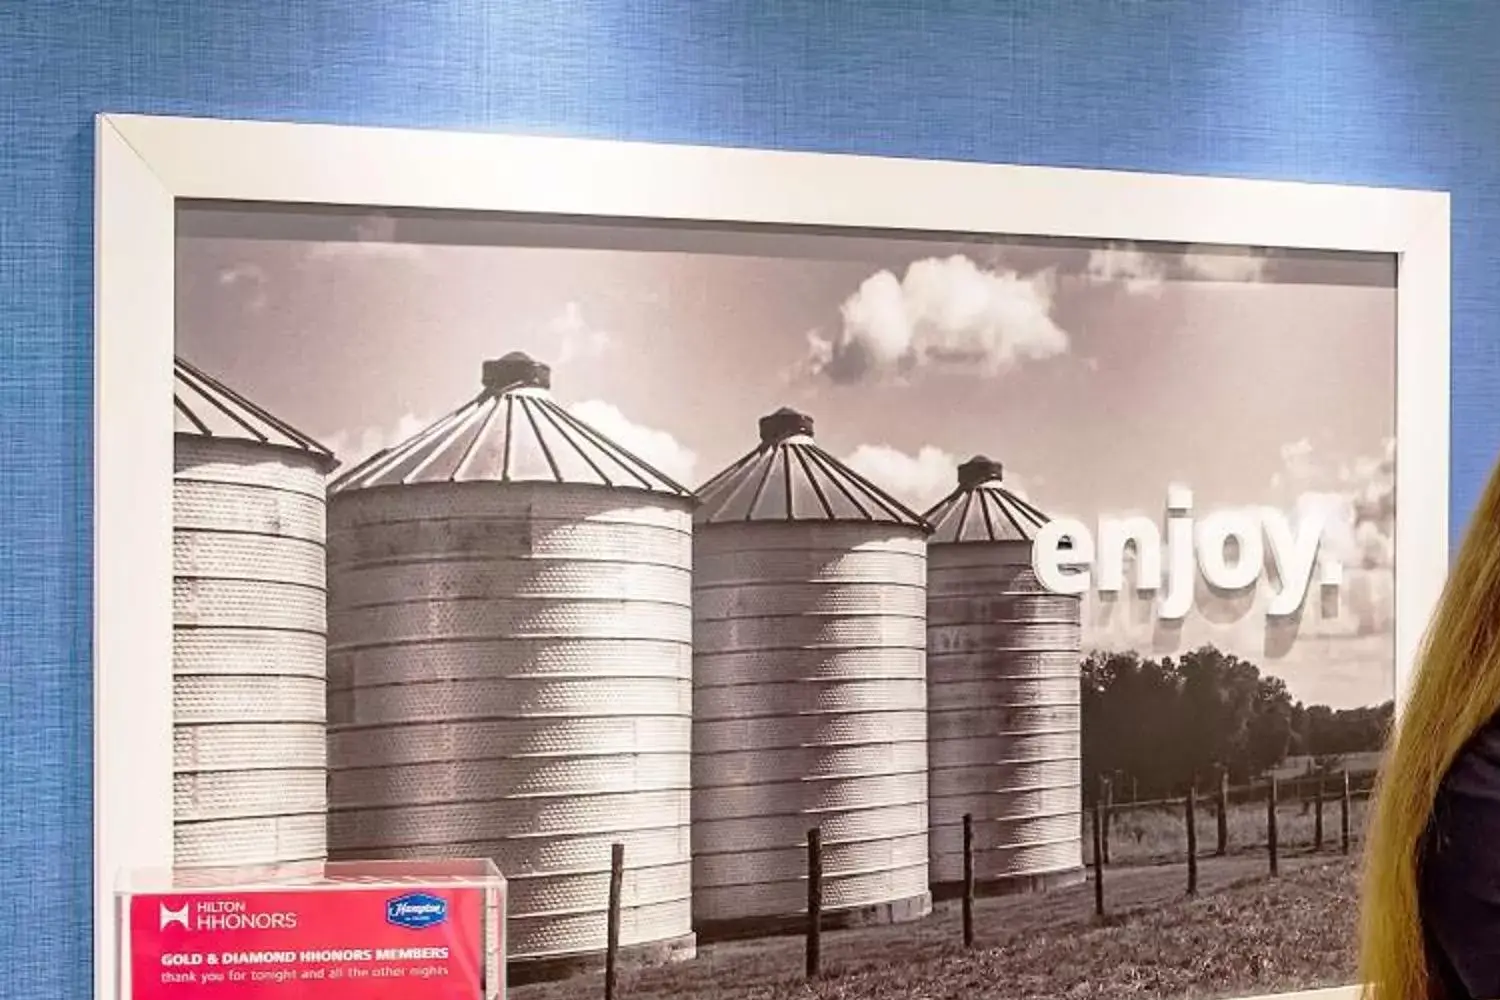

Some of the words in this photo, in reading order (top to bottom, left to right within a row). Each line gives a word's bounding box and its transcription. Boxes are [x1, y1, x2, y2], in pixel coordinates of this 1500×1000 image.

[1032, 484, 1344, 619] enjoy.
[197, 900, 246, 912] HILTON
[197, 912, 298, 930] HHONORS
[161, 952, 202, 966] GOLD
[207, 952, 219, 965] &
[221, 951, 297, 965] DIAMOND
[299, 949, 372, 962] HHONORS
[375, 947, 449, 961] MEMBERS
[161, 970, 197, 983] thank
[201, 971, 225, 984] you
[228, 969, 247, 981] for
[250, 968, 297, 982] tonight
[300, 968, 325, 980] and
[327, 966, 343, 979] all
[347, 966, 369, 977] the
[371, 965, 406, 977] other
